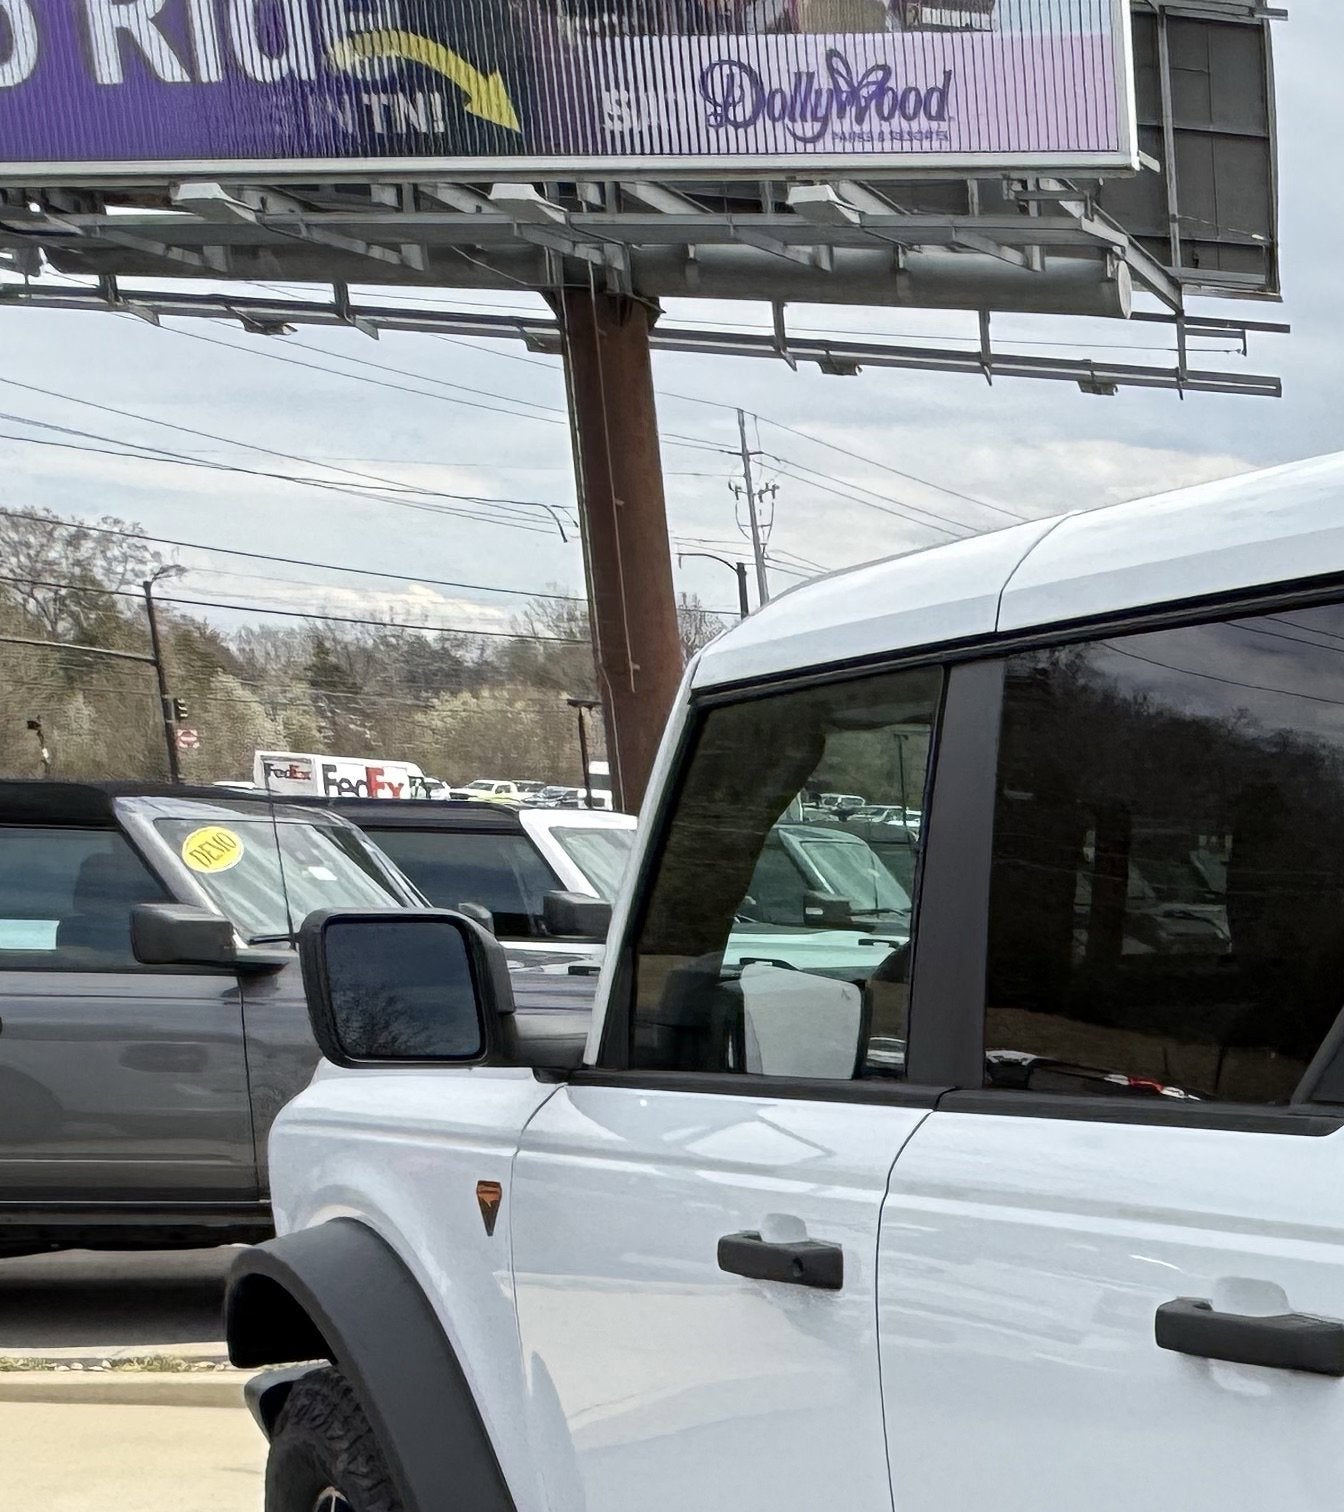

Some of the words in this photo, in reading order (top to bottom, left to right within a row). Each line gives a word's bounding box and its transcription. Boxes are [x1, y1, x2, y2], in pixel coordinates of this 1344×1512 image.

[264, 763, 312, 781] FedEx
[321, 764, 405, 799] FedEx
[189, 832, 237, 868] DEMO
